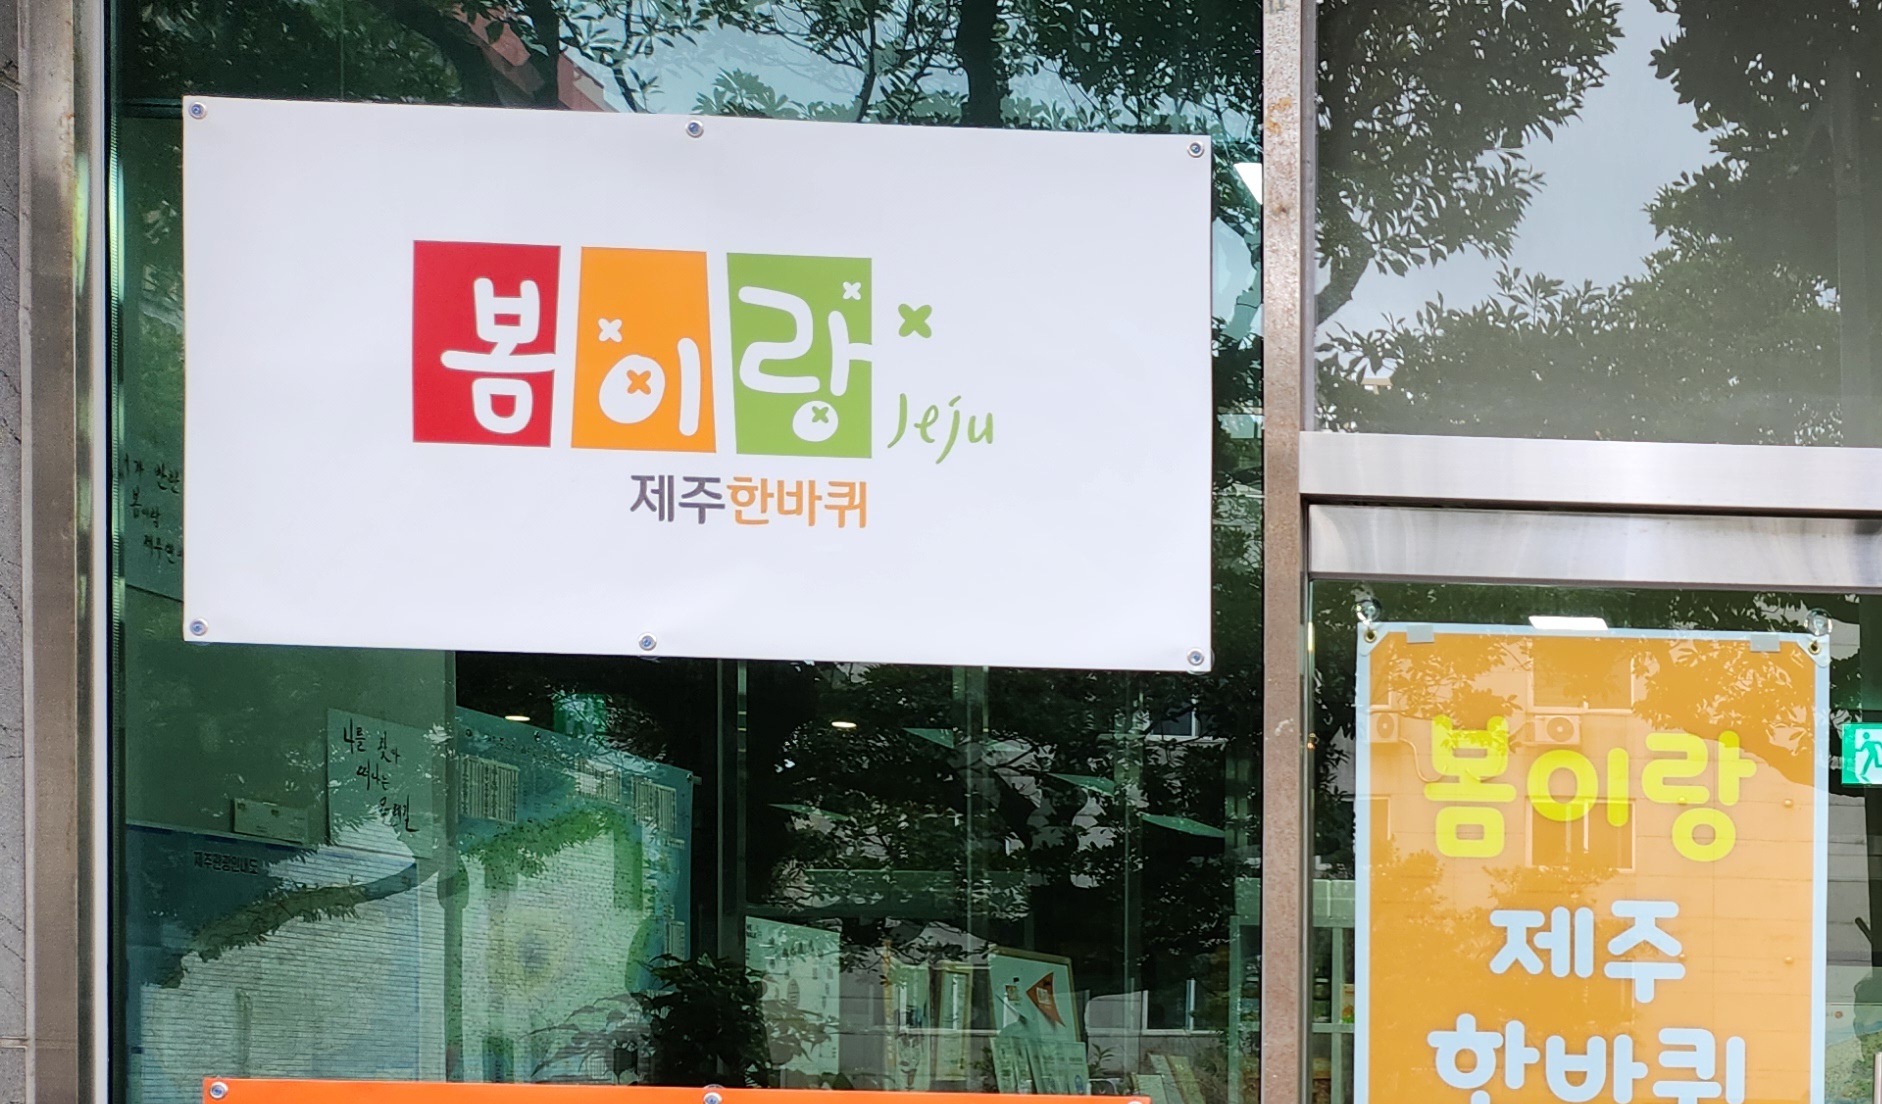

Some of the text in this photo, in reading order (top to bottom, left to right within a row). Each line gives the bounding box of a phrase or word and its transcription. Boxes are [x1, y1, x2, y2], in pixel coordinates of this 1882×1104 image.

[440, 276, 872, 443] 봄이랑
[887, 393, 995, 464] Jeju
[628, 472, 868, 529] 제주한바퀴
[1423, 714, 1757, 863] 봄이랑
[1489, 900, 1686, 1003] 제주
